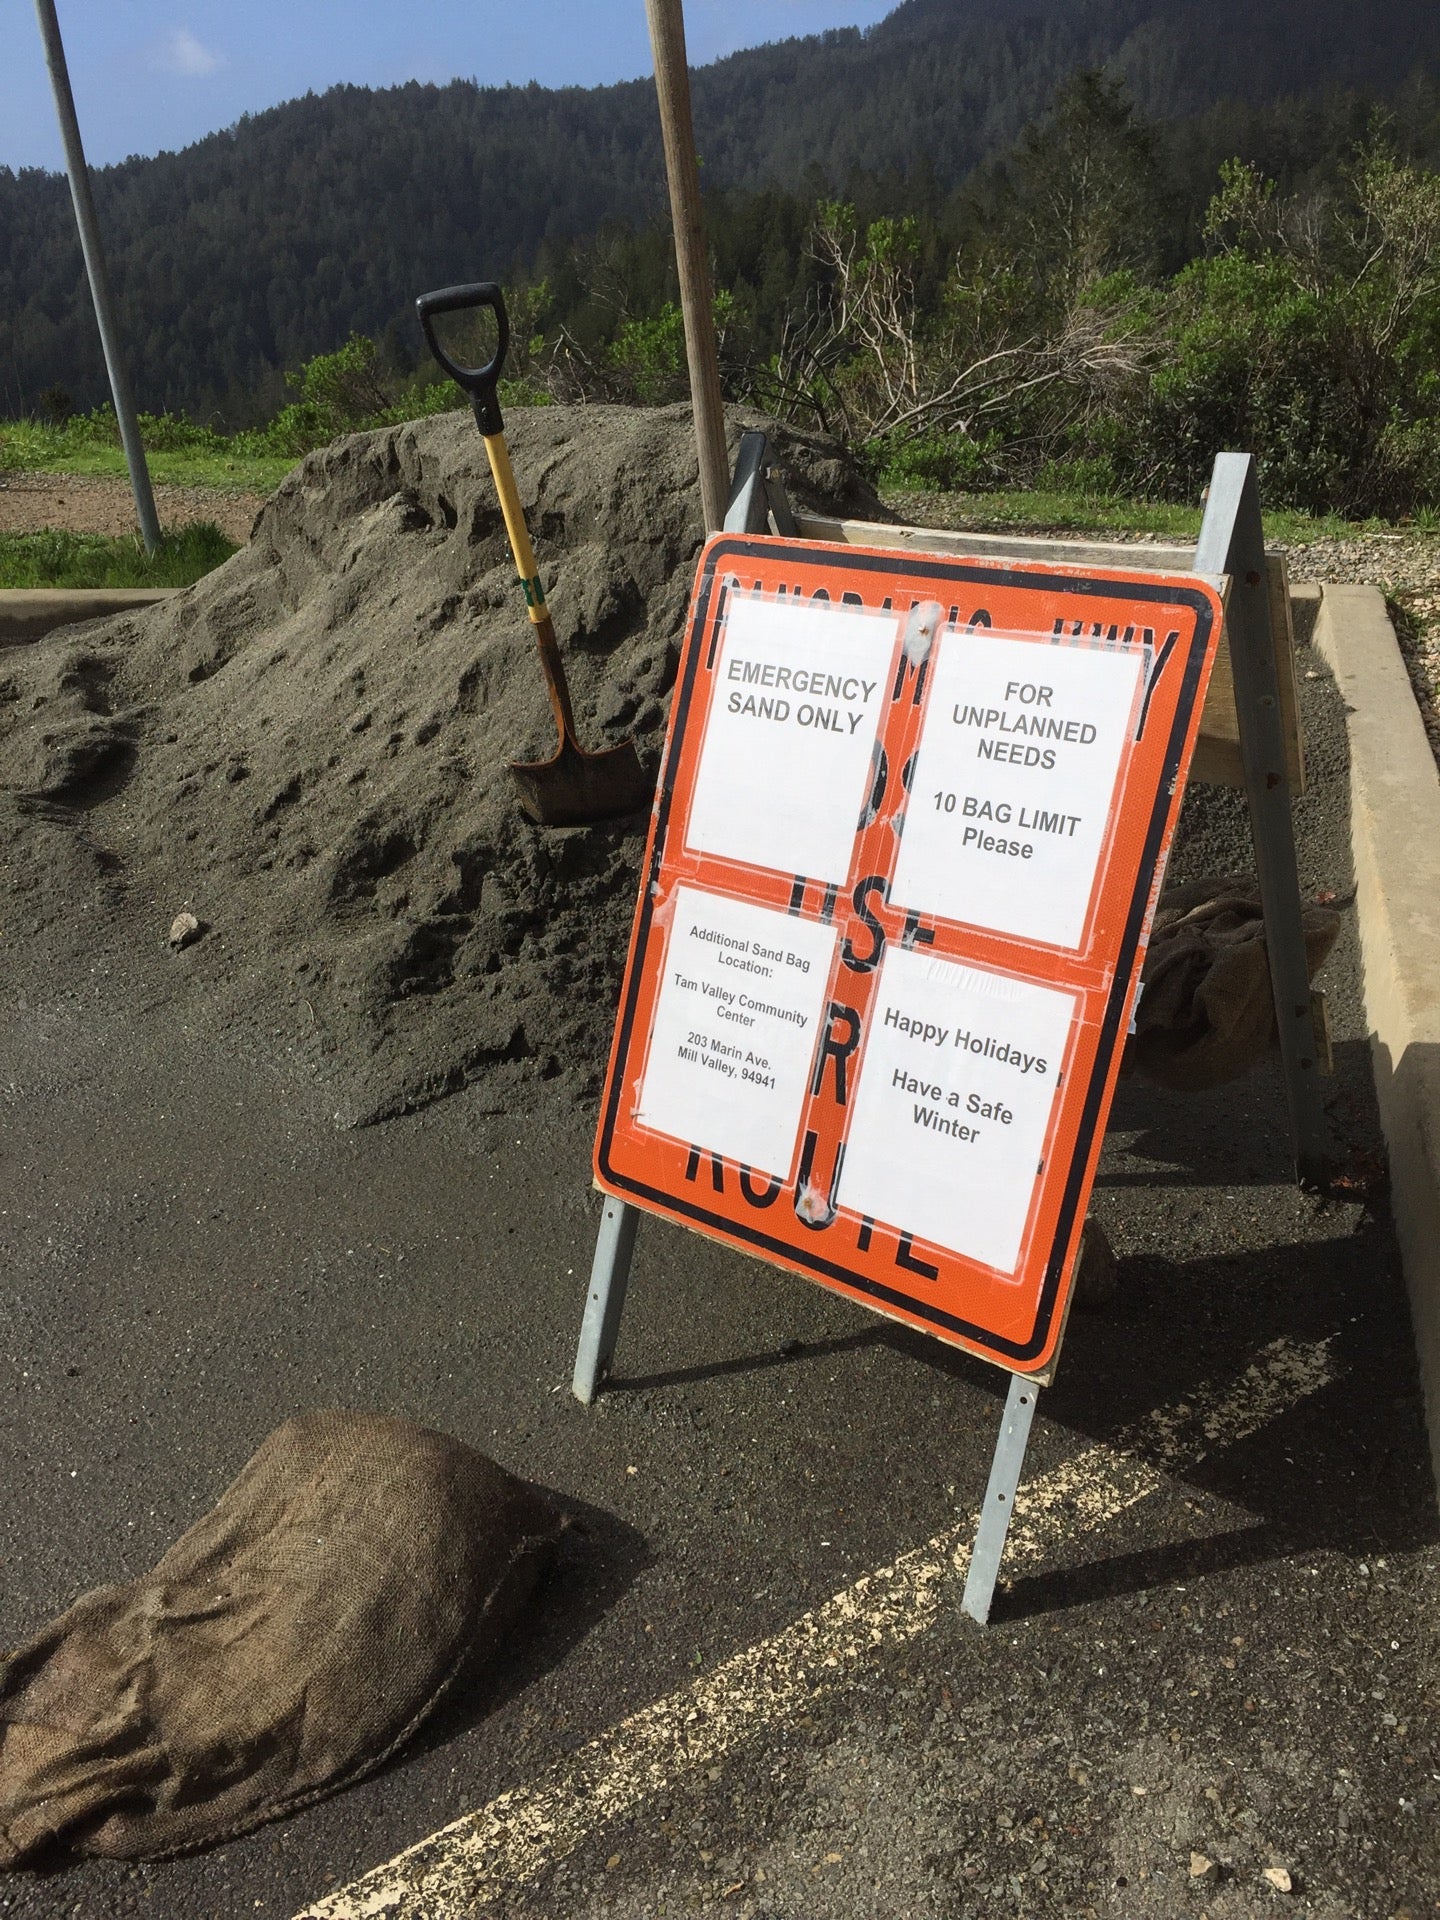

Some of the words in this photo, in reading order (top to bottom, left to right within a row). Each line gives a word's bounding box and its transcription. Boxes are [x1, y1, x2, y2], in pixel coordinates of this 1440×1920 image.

[728, 659, 878, 703] EMERGENCY
[1004, 681, 1054, 708] FOR
[727, 691, 790, 722] SAND
[796, 704, 864, 735] ONLY
[952, 704, 1097, 745] UNPLANNED
[977, 738, 1057, 770] NEEDS
[933, 791, 957, 813] 10
[962, 796, 1012, 824] BAG
[1018, 807, 1082, 837] LIMIT
[962, 826, 1034, 860] Please
[689, 925, 750, 953] Additional
[751, 943, 784, 963] Sand
[785, 952, 811, 974] Bag
[718, 951, 774, 979] Location:
[674, 973, 698, 992] Tam
[701, 981, 736, 1006] Valley
[738, 993, 808, 1029] Community
[716, 1005, 756, 1027] Center
[687, 1031, 708, 1048] 203
[710, 1038, 743, 1061] Marin
[744, 1051, 771, 1071] Ave.
[883, 1007, 950, 1047] Happy
[954, 1028, 1048, 1074] Holidays
[677, 1045, 698, 1063] Mill
[701, 1053, 738, 1079] Valley,
[741, 1067, 776, 1091] 94941
[891, 1068, 942, 1102] Have
[947, 1091, 960, 1108] a
[966, 1093, 1013, 1125] Safe
[913, 1103, 981, 1144] Winter
